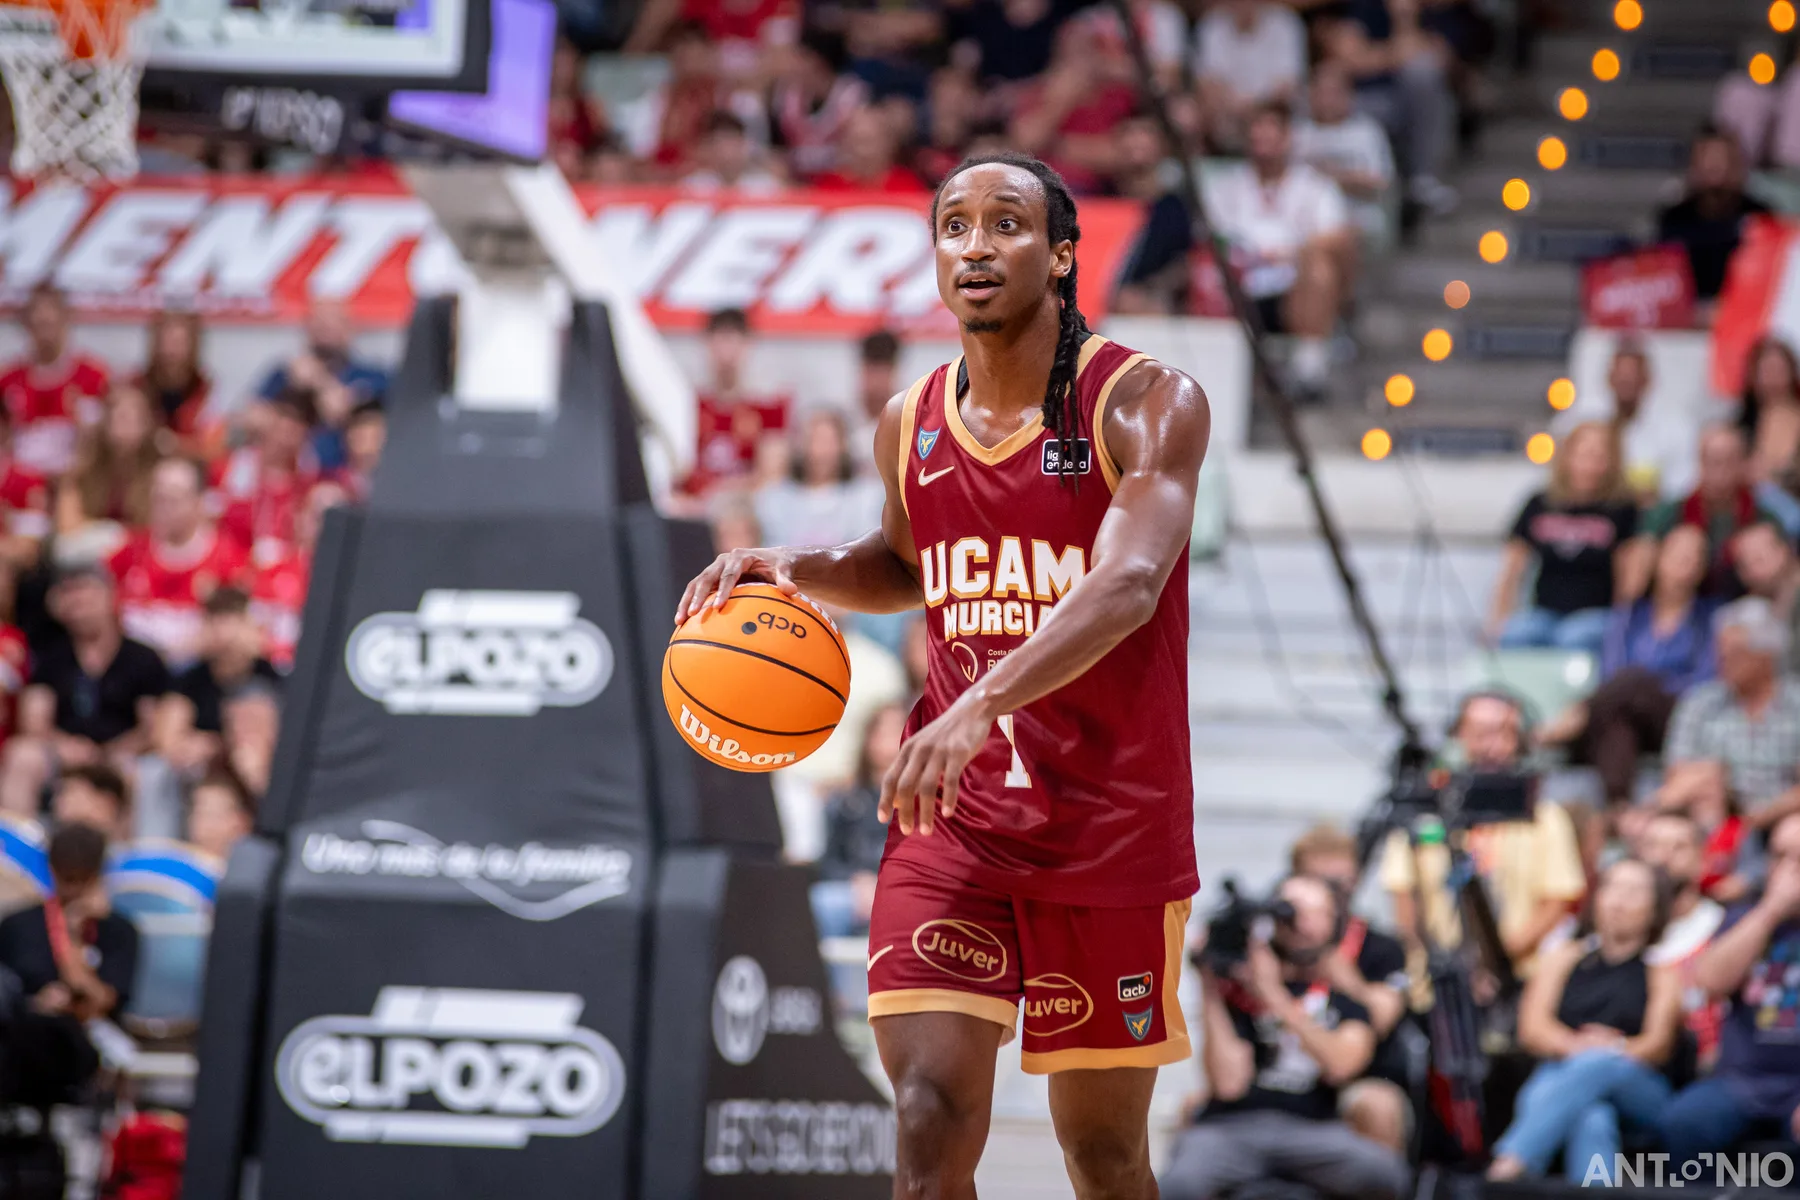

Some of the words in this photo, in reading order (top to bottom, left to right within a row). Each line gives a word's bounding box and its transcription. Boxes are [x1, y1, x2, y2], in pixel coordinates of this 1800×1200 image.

[921, 536, 1086, 608] UCAM
[757, 612, 807, 639] acb
[987, 648, 1007, 656] Costa
[679, 703, 796, 765] Wilson
[922, 931, 999, 971] Juver
[1122, 983, 1146, 998] acb
[1025, 997, 1082, 1018] uver
